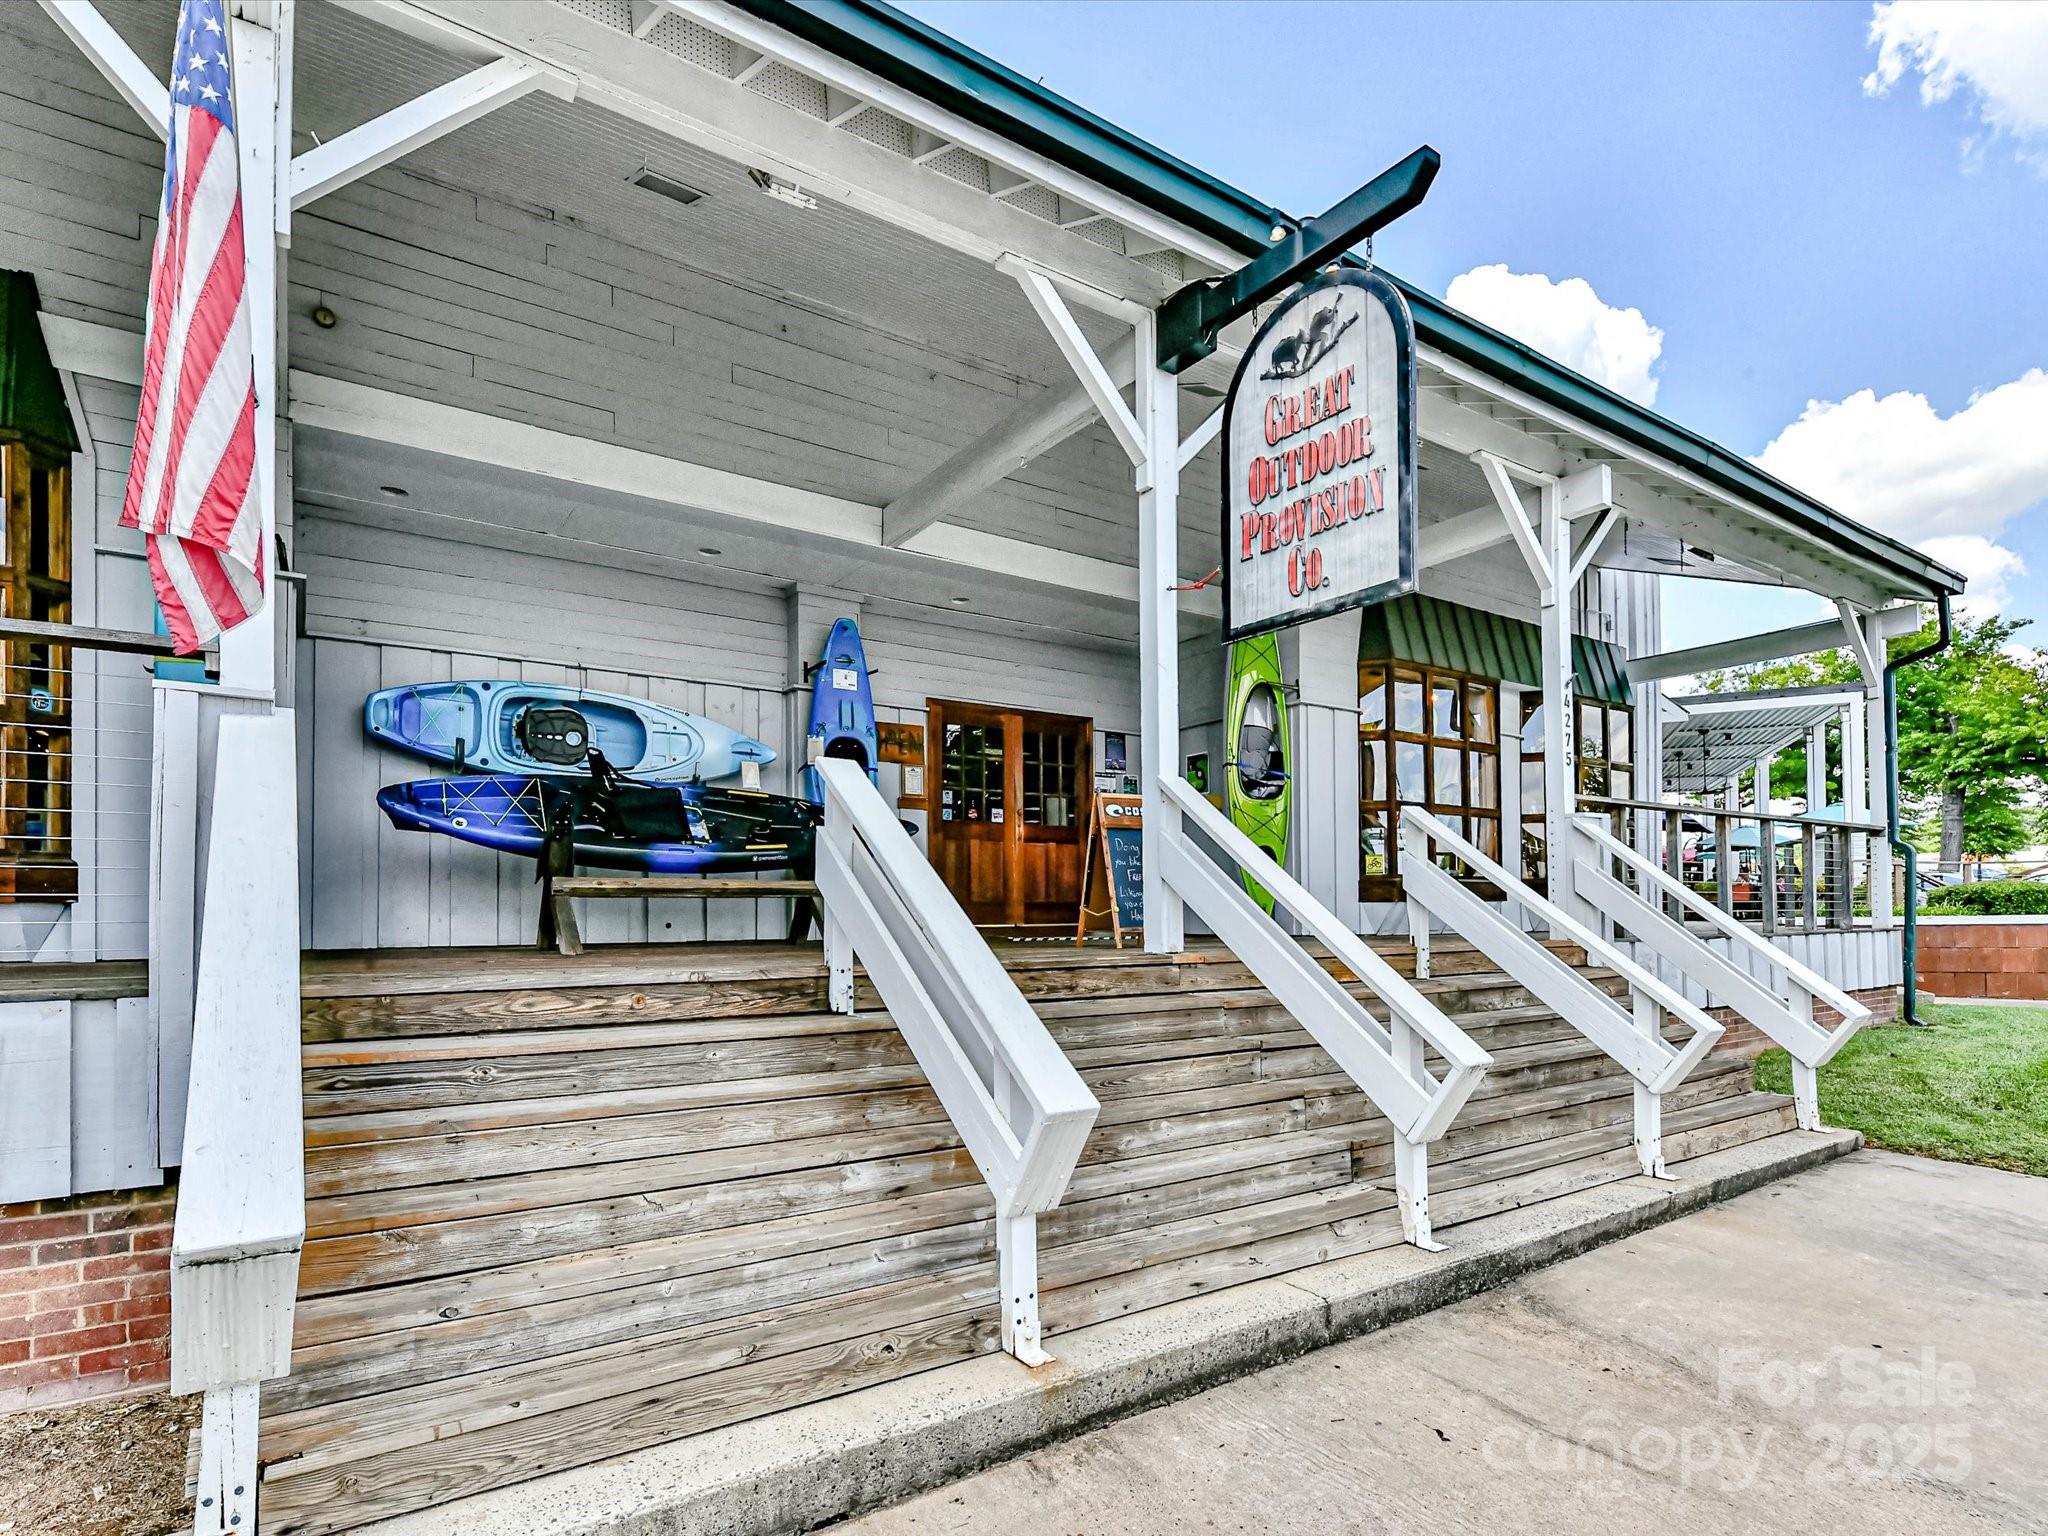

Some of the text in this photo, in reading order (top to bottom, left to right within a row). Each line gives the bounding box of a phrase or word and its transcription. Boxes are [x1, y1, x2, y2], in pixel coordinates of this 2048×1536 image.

[1264, 364, 1355, 448] GREAT
[1248, 415, 1375, 507] OUTDOOR
[1240, 465, 1387, 562] PROVISION
[1563, 694, 1572, 767] 4275
[1115, 837, 1140, 858] Doing
